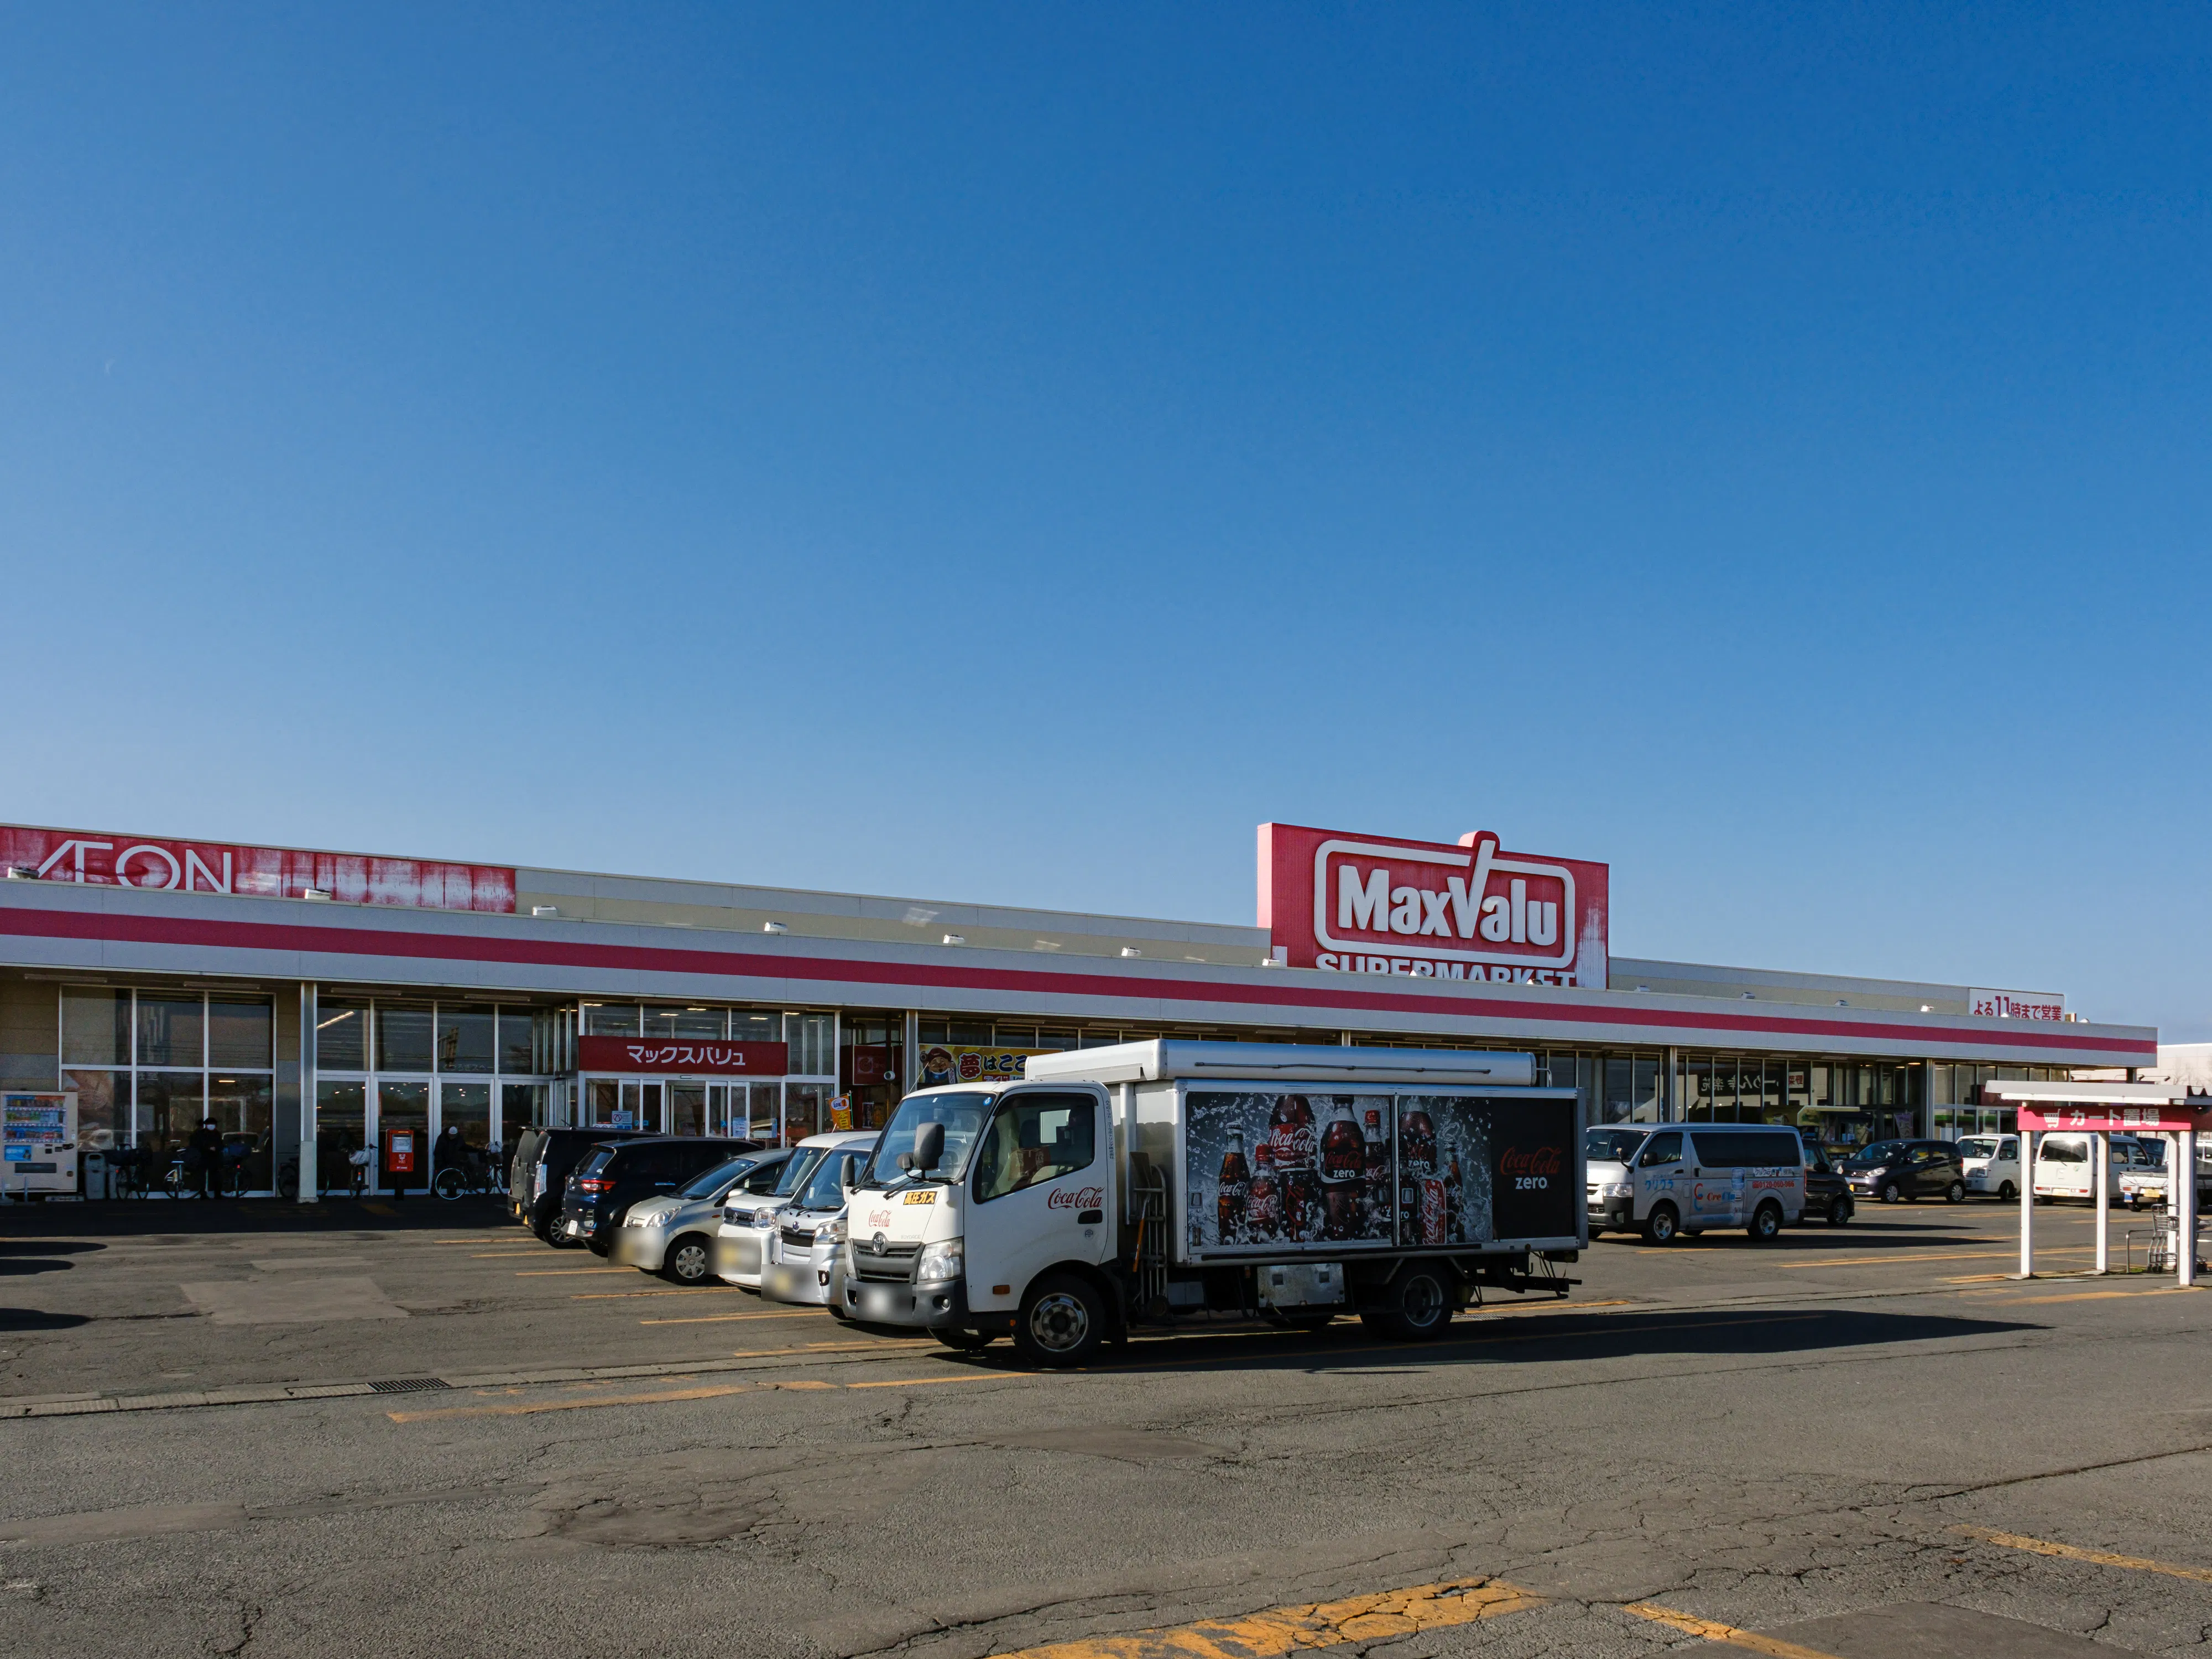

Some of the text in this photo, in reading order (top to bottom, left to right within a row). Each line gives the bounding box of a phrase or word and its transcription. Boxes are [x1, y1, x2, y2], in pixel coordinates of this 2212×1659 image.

[1338, 839, 1557, 946] MaxValu
[1974, 995, 2062, 1021] よる11時まで営業
[627, 1045, 746, 1066] マックスバリュ
[2070, 1109, 2159, 1126] カート置場
[1500, 1146, 1562, 1175] Coca-Cola
[1333, 1170, 1355, 1178] zero
[1515, 1177, 1547, 1190] zero
[904, 1191, 936, 1205] 高圧ガス
[1048, 1186, 1105, 1209] Coca-Cola
[869, 1209, 891, 1227] Coca-Cola
